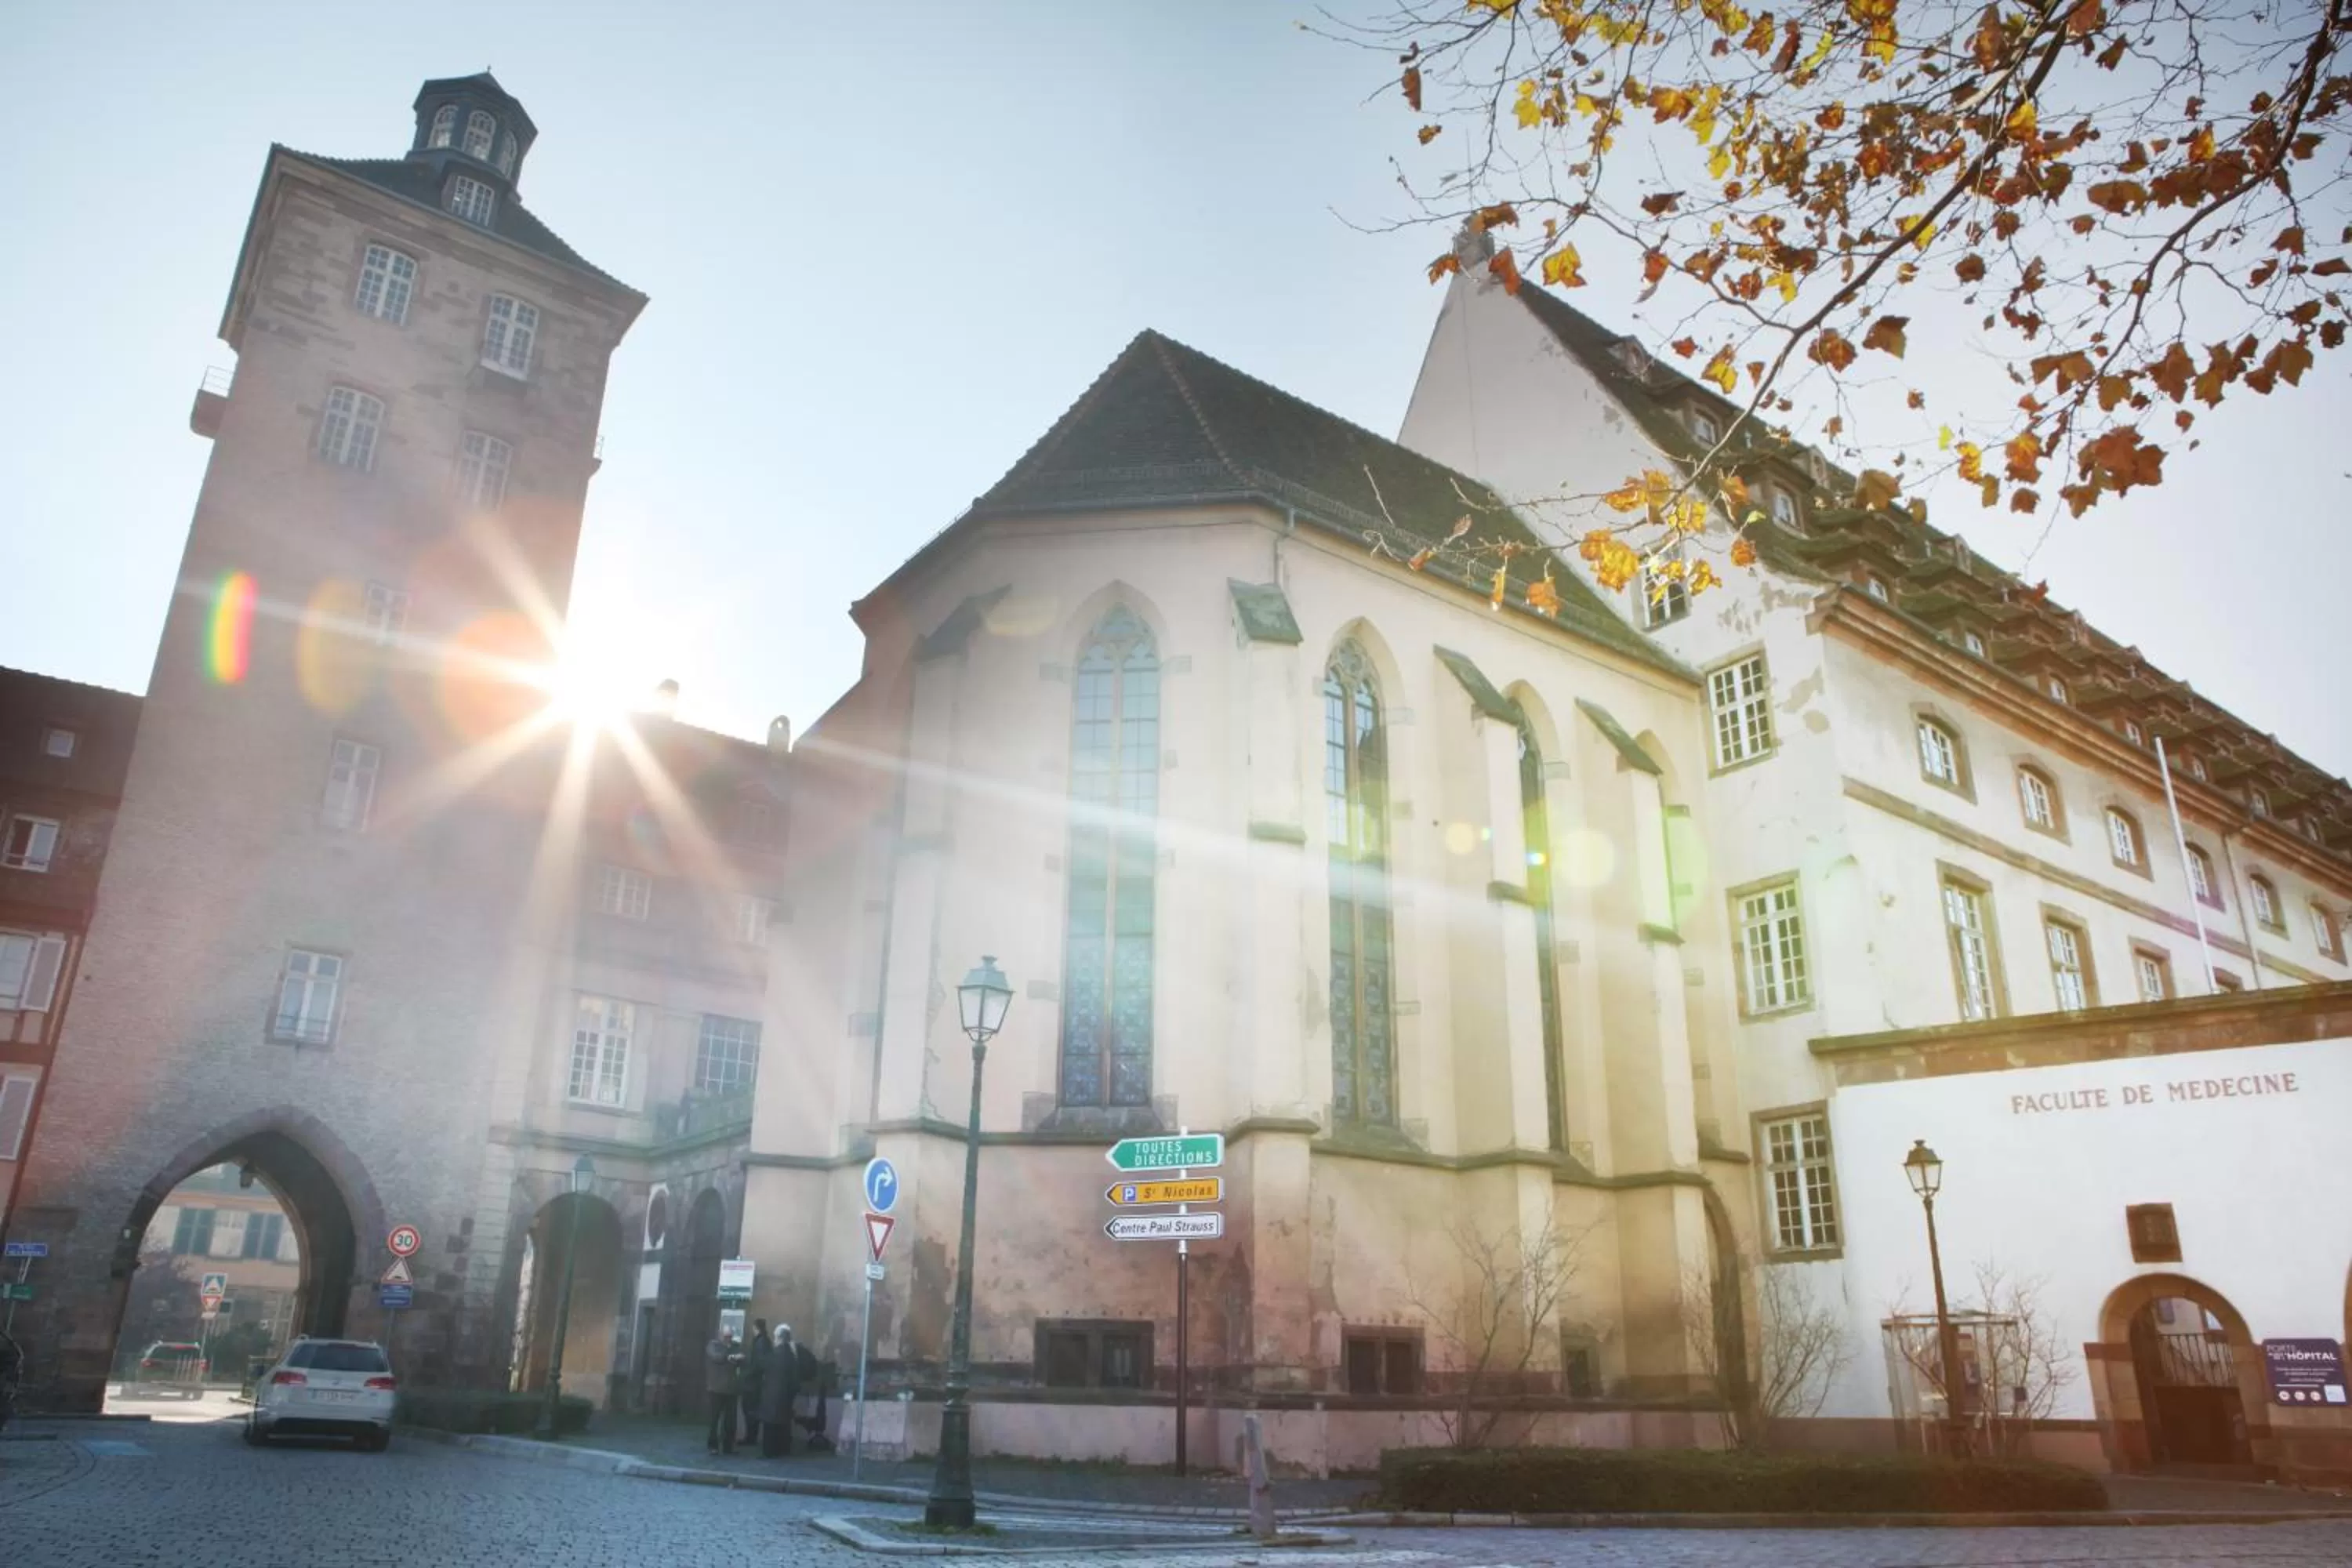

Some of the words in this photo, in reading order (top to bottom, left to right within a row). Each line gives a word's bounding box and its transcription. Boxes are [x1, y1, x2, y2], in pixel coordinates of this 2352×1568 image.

[2011, 1089, 2108, 1114] FACULTE
[2122, 1084, 2154, 1105] DE
[2167, 1073, 2299, 1102] MEDECINE
[1134, 1141, 1181, 1153] TOUTES
[1134, 1150, 1213, 1167] DIRECTIONS
[1163, 1185, 1213, 1197] Nicolas
[1112, 1222, 1146, 1234] Centre
[1149, 1221, 1171, 1233] Paul
[1175, 1221, 1214, 1232] Strauss
[395, 1234, 412, 1247] 30
